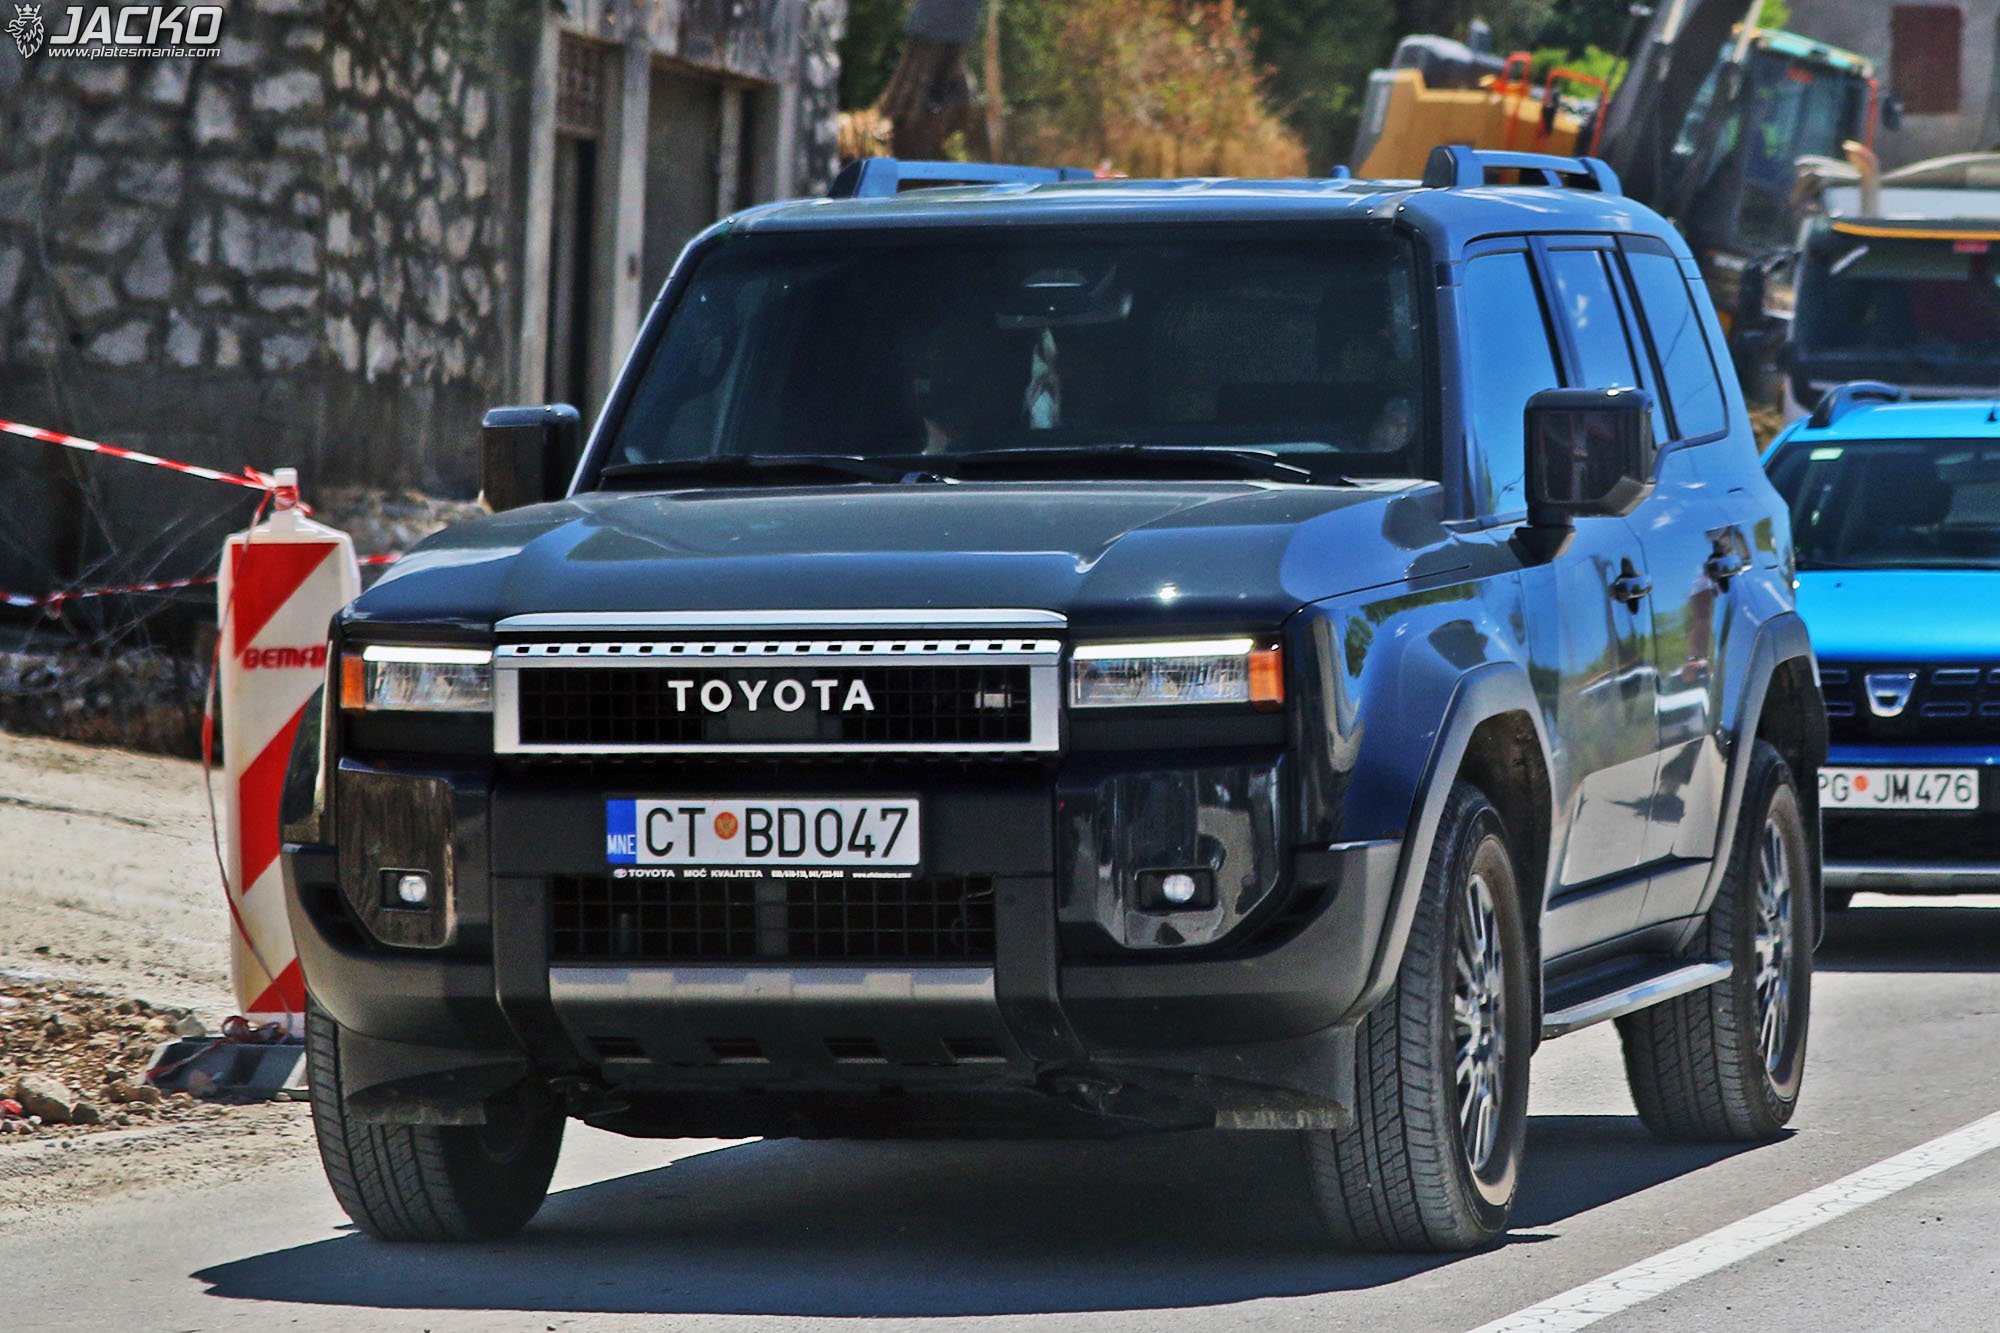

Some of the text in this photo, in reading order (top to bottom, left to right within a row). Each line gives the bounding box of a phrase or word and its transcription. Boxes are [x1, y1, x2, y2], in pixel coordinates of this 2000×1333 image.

[667, 679, 875, 712] TOYOTA
[1873, 774, 1972, 804] JM476
[607, 833, 636, 855] MNE
[645, 807, 910, 859] CT BD047
[628, 869, 676, 878] TOYOTA
[710, 869, 764, 878] KVALITETA
